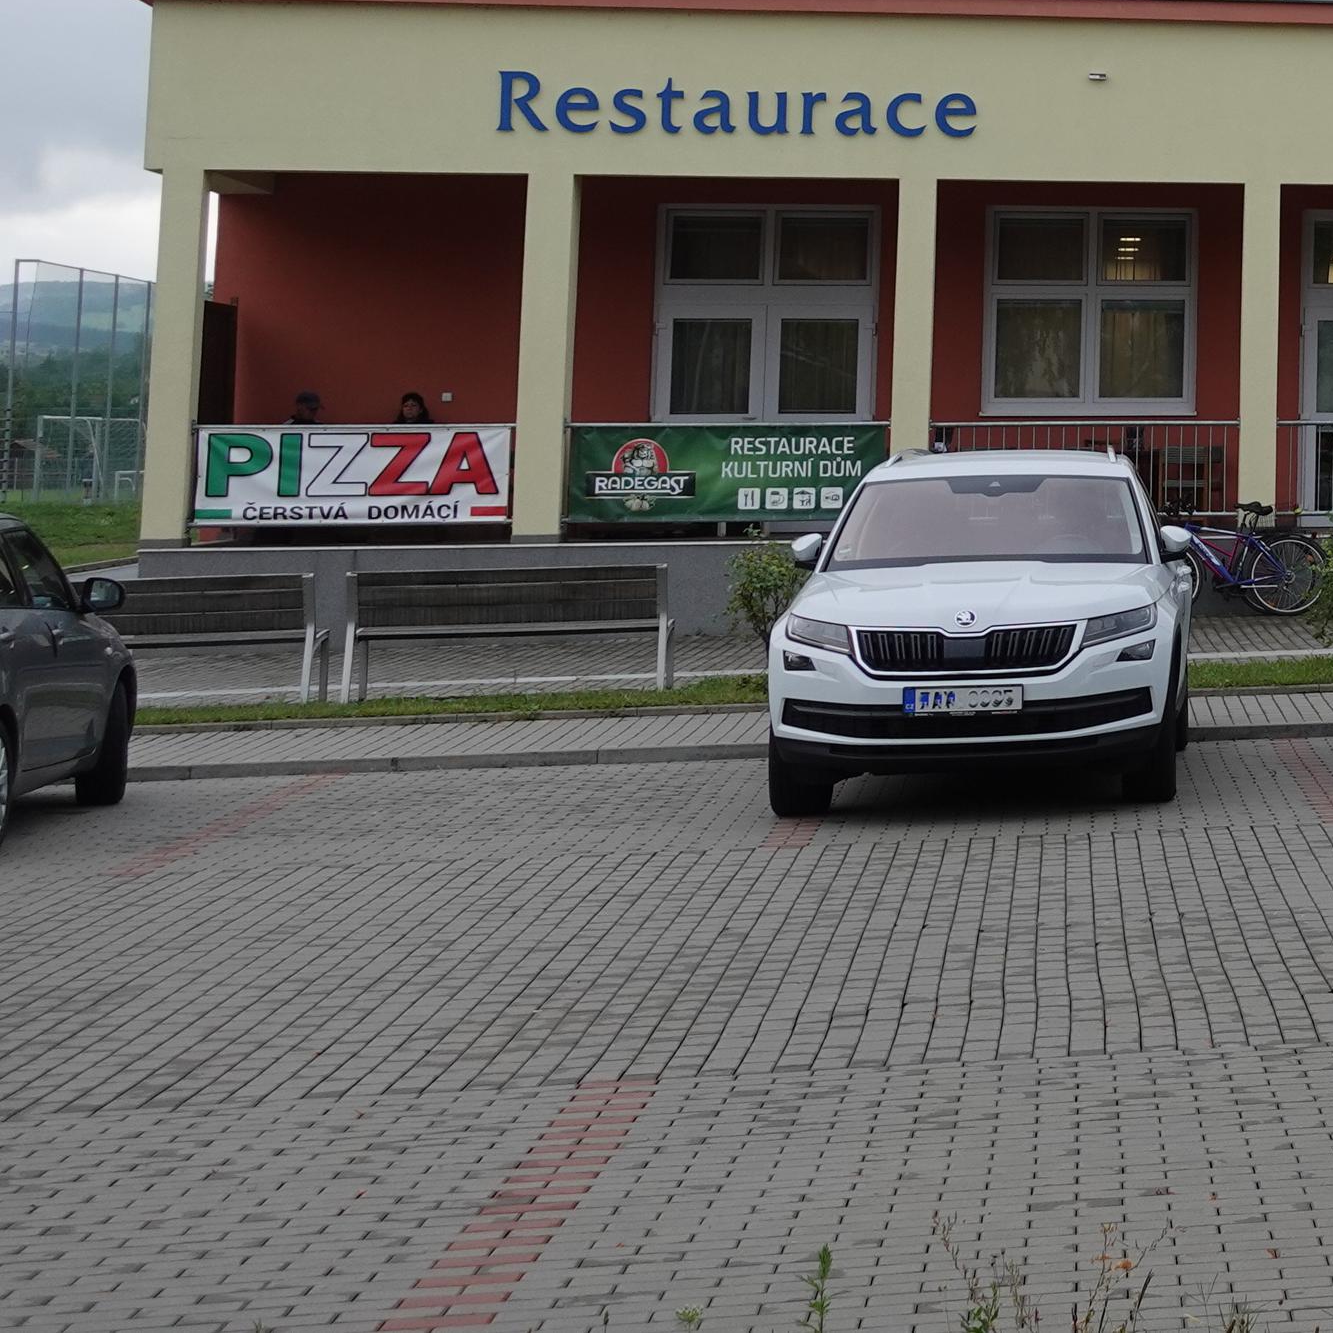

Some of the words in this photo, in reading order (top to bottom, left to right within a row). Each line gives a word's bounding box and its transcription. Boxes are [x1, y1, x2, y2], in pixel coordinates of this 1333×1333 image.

[496, 70, 977, 138] Restaurace
[730, 436, 856, 456] RESTAURACE
[204, 431, 499, 498] PIZZA
[721, 457, 813, 479] KULTURNÍ
[818, 456, 862, 479] DŮM
[594, 474, 690, 496] RADEGAST
[242, 501, 349, 521] ČERSTVÁ
[367, 500, 460, 521] DOMÁCÍ
